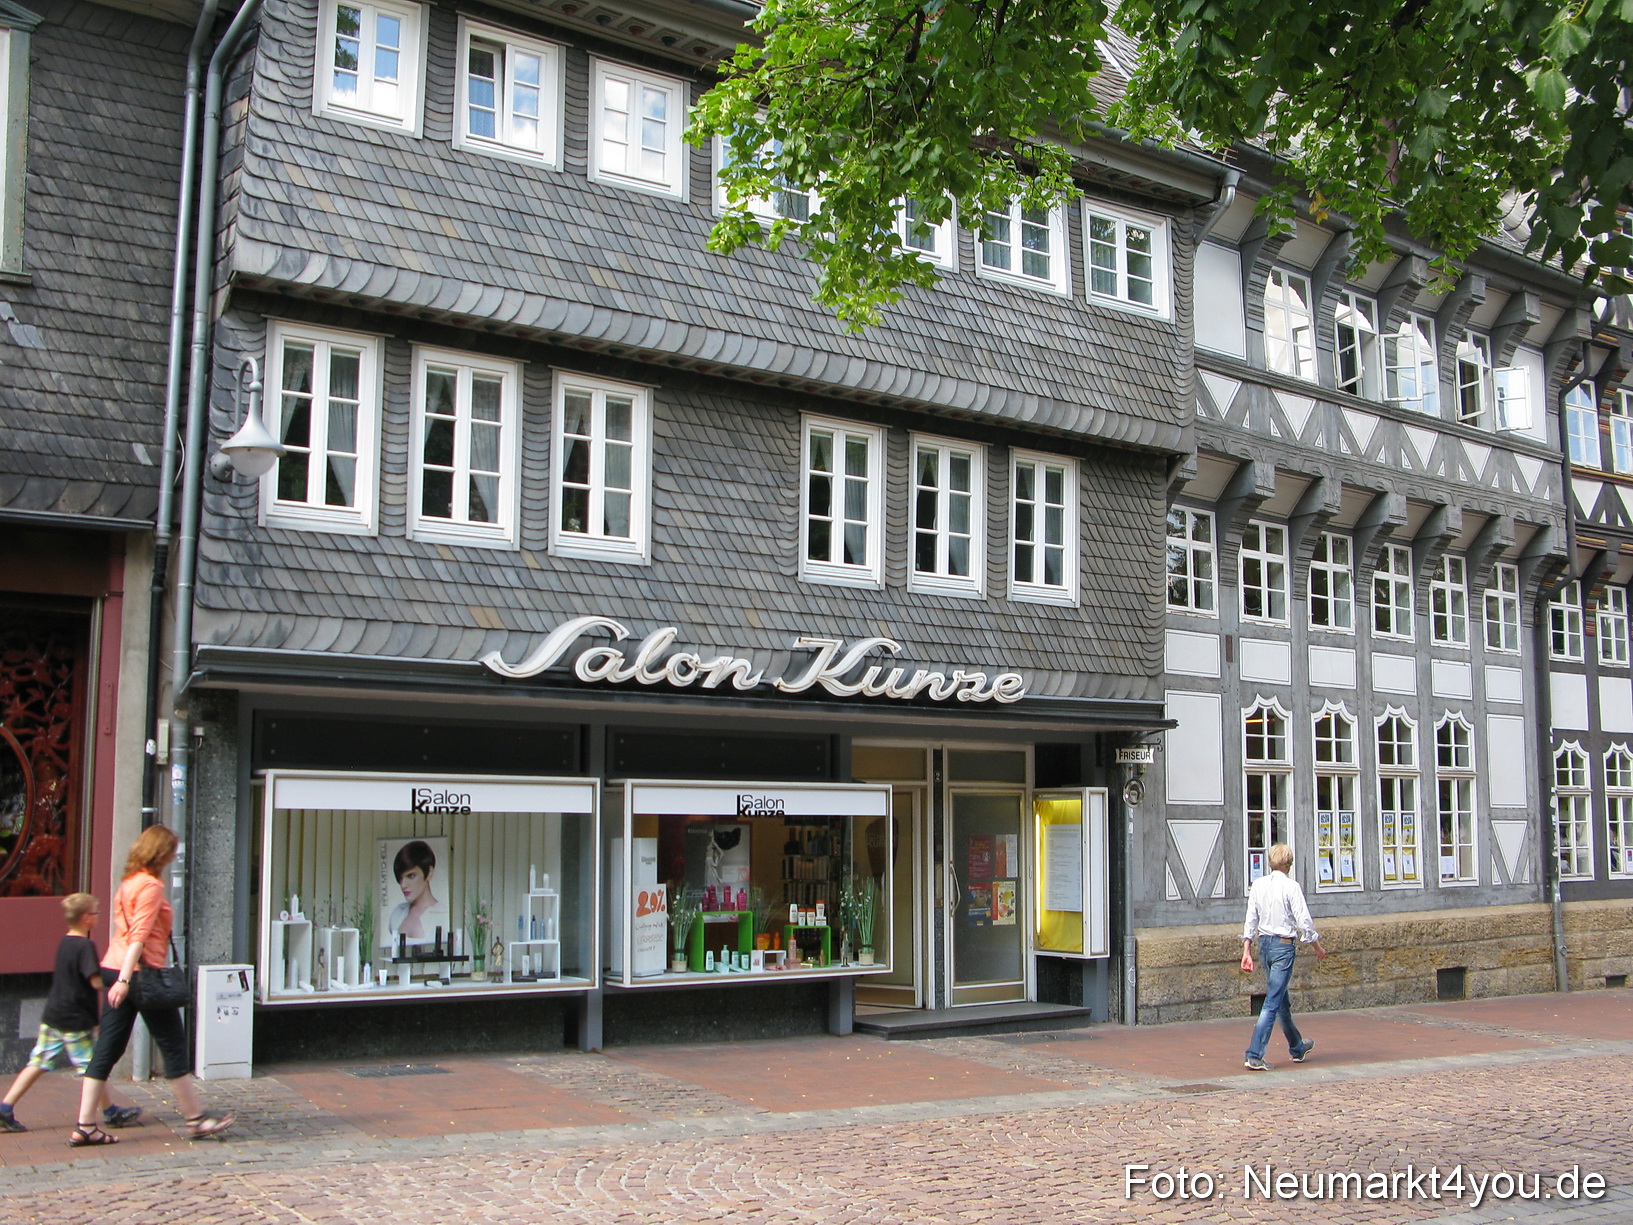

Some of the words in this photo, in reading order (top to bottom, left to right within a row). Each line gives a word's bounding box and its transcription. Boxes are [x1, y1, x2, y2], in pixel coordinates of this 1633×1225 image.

[484, 616, 762, 691] Salon
[773, 636, 1025, 703] Kunze
[1118, 751, 1150, 760] FRISEUR
[411, 788, 472, 815] Kunze
[417, 788, 471, 806] Salon
[737, 795, 785, 818] Kunze
[741, 795, 785, 810] Salon
